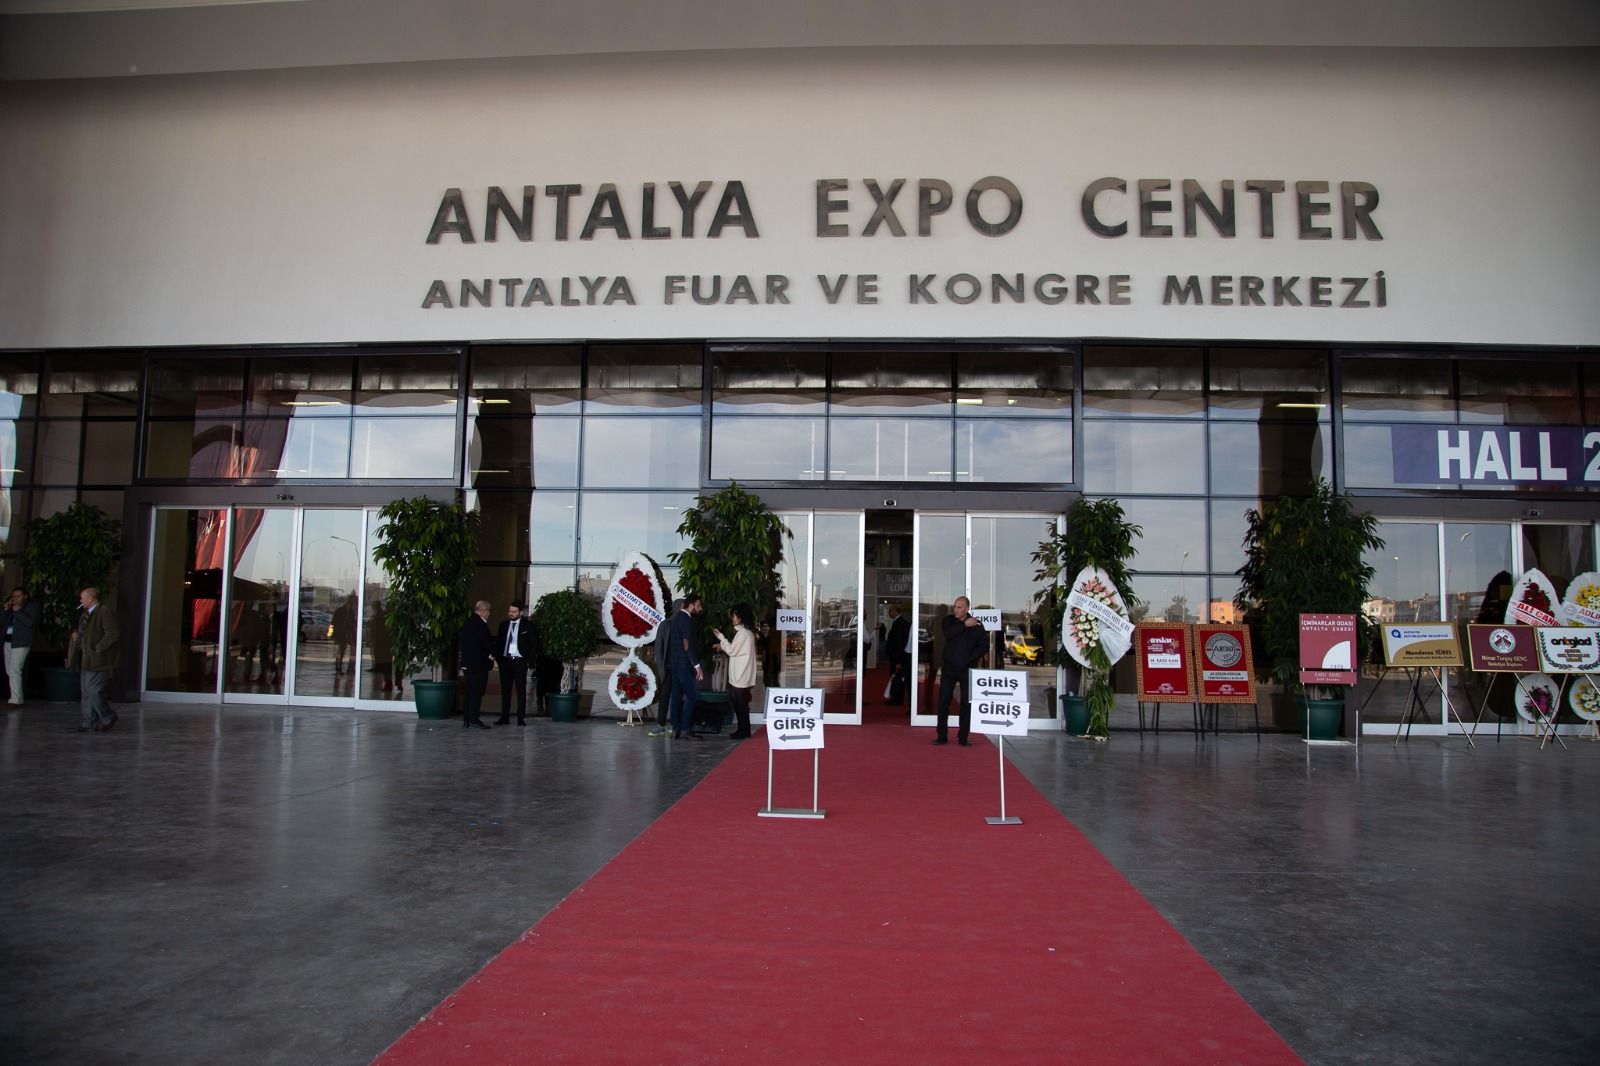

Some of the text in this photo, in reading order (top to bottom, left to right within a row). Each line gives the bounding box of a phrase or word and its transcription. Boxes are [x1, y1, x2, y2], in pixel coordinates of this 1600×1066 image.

[425, 176, 1384, 244] ANTALYA EXPO CENTER
[421, 271, 1387, 309] ANTALYA FUAR VE KONGRE MERKEZİ
[1437, 430, 1567, 481] HALL
[780, 615, 803, 624] ÇIKIŞ
[976, 676, 1019, 690] GİRİŞ
[773, 694, 814, 707] GİRİŞ
[978, 701, 1021, 718] GİRİŞ
[773, 717, 816, 731] GİRİŞ
